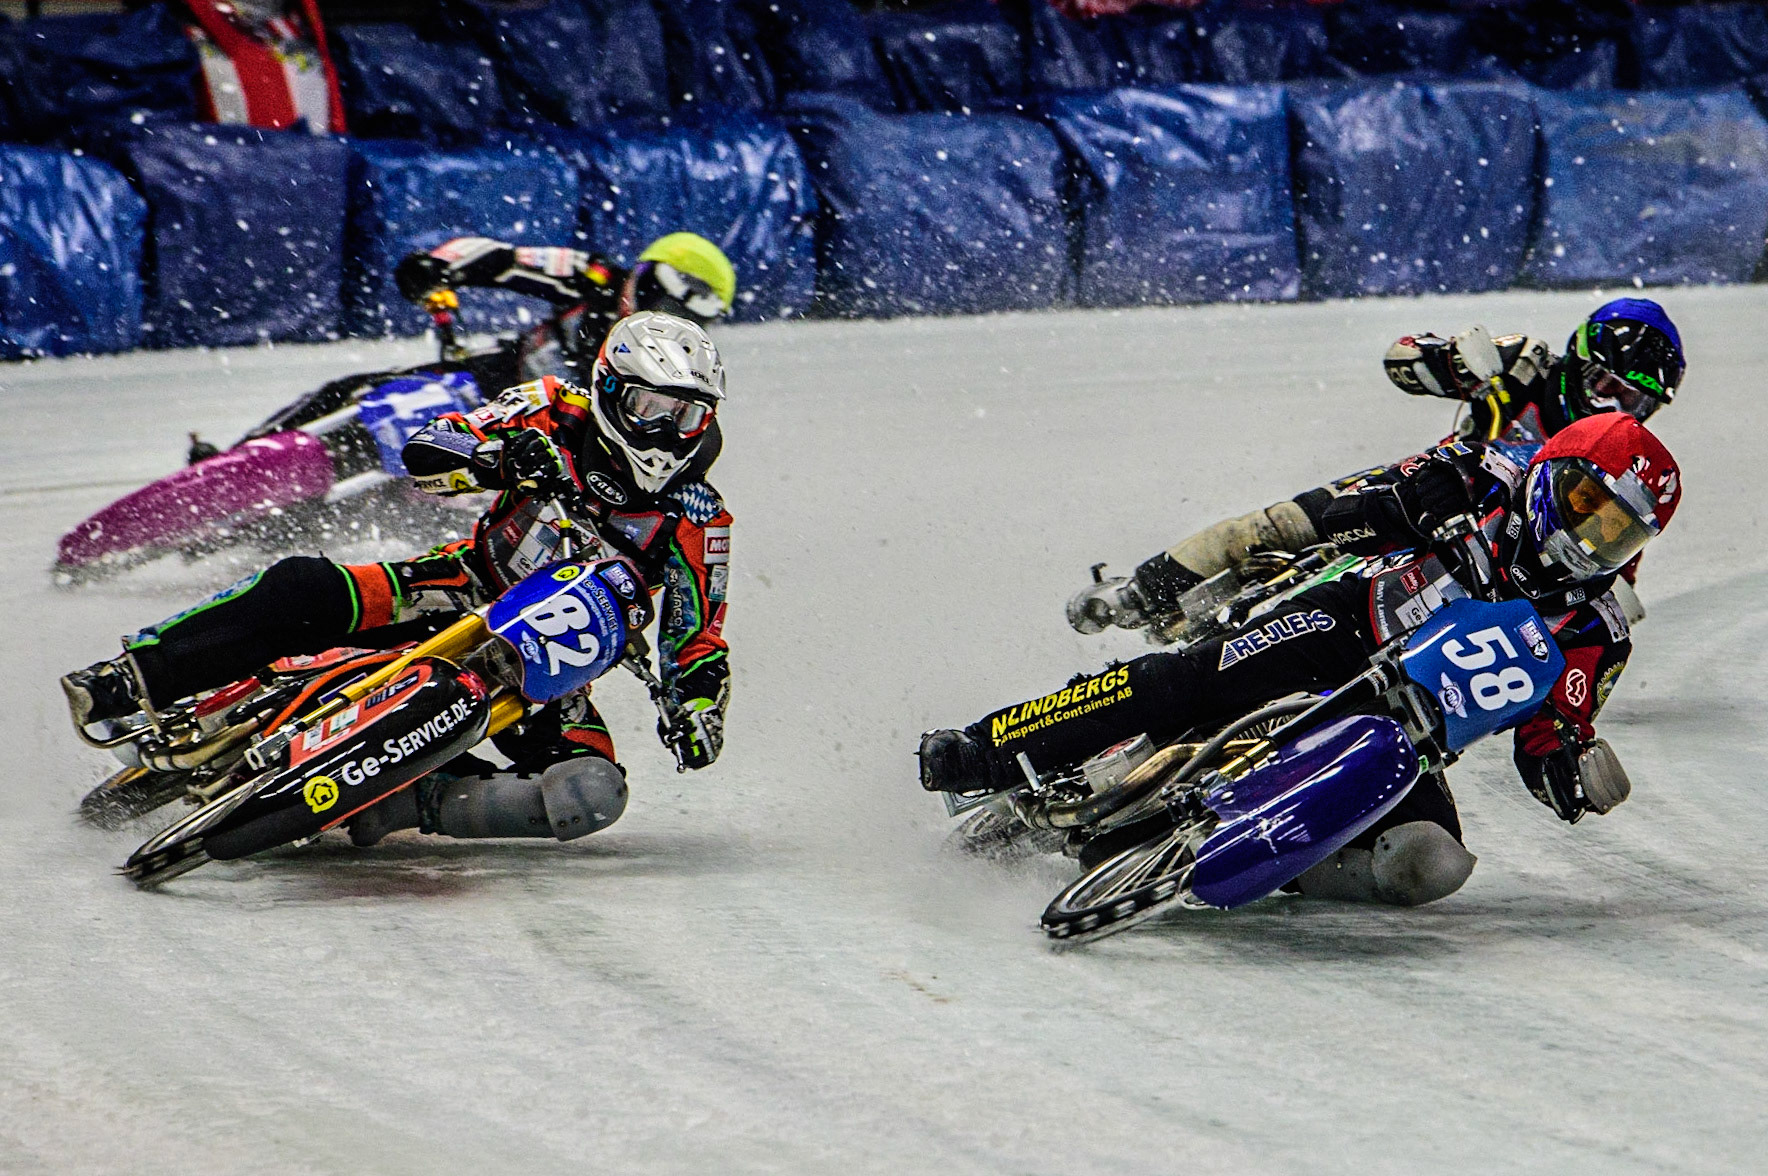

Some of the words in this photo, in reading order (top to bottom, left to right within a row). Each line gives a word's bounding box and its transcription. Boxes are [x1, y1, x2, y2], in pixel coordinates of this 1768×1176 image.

[519, 593, 600, 677] 82
[1441, 625, 1535, 711] 58
[1117, 686, 1133, 702] AB
[341, 697, 473, 787] Ge-SERVICE.DE
